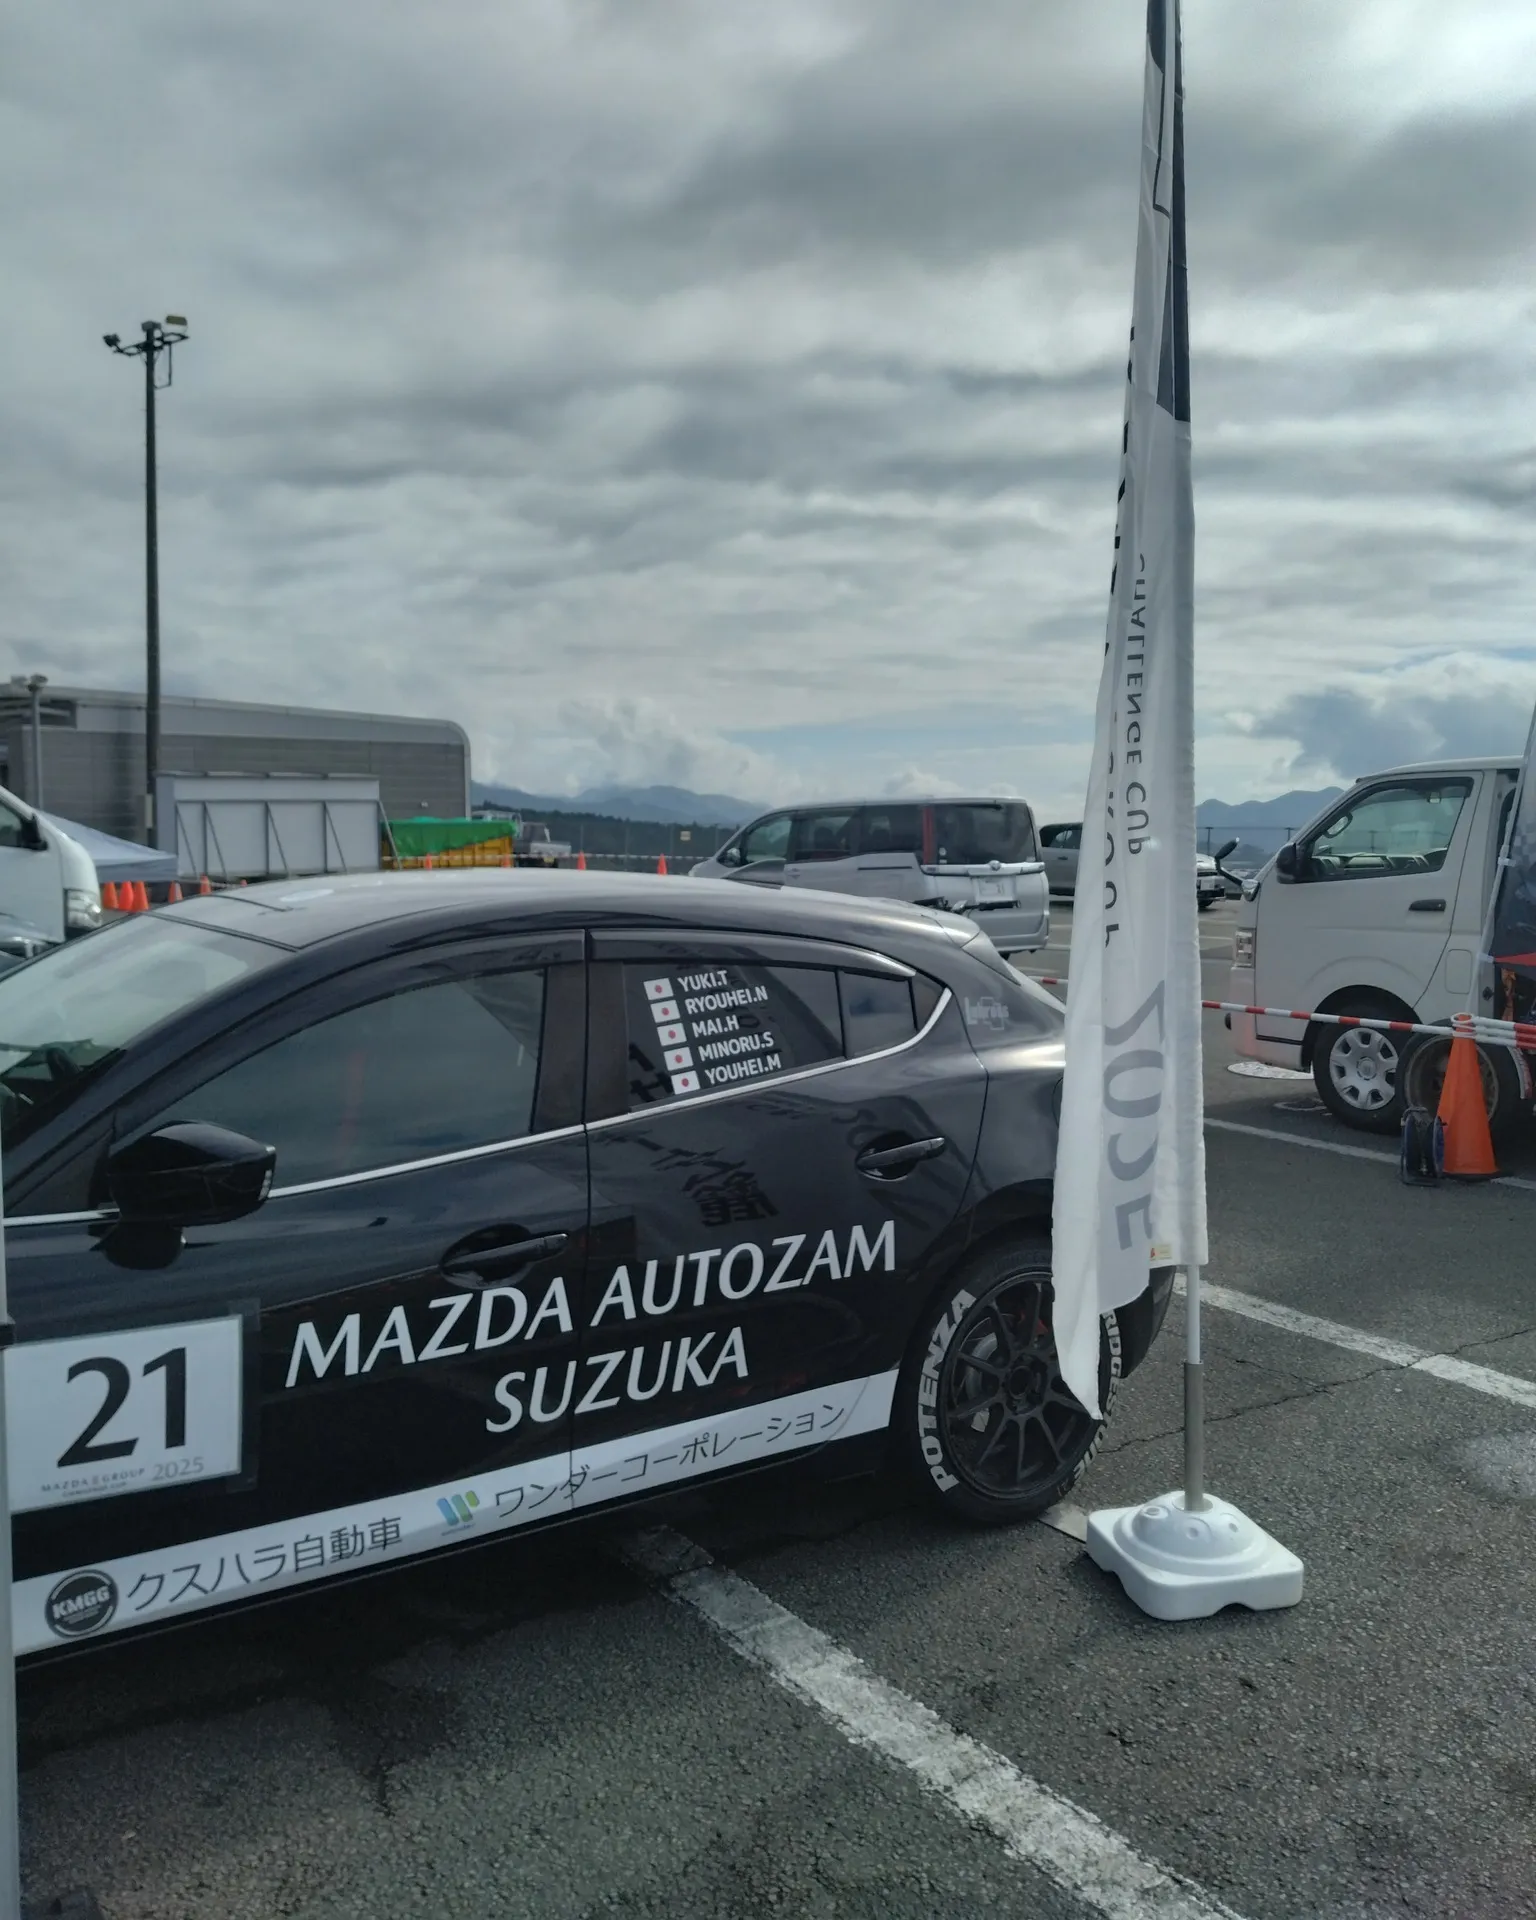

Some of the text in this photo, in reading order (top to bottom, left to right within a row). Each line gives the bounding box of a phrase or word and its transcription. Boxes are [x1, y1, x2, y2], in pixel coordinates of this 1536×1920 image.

[677, 970, 728, 992] YUKI.T
[684, 985, 768, 1015] RYOUHEI.N
[692, 1014, 740, 1038] MAI.H
[698, 1031, 774, 1062] MINORU.S
[705, 1053, 782, 1085] YOUHEI.M
[285, 1276, 574, 1388] MAZDA
[590, 1220, 896, 1326] AUTOZAM
[57, 1347, 187, 1468] 21
[486, 1326, 749, 1433] SUZUKA
[918, 1289, 977, 1492] POTENZA
[151, 1456, 206, 1482] 2025
[495, 1403, 846, 1518] ワンダーコーポレーション
[127, 1516, 403, 1611] クスハラ自動車
